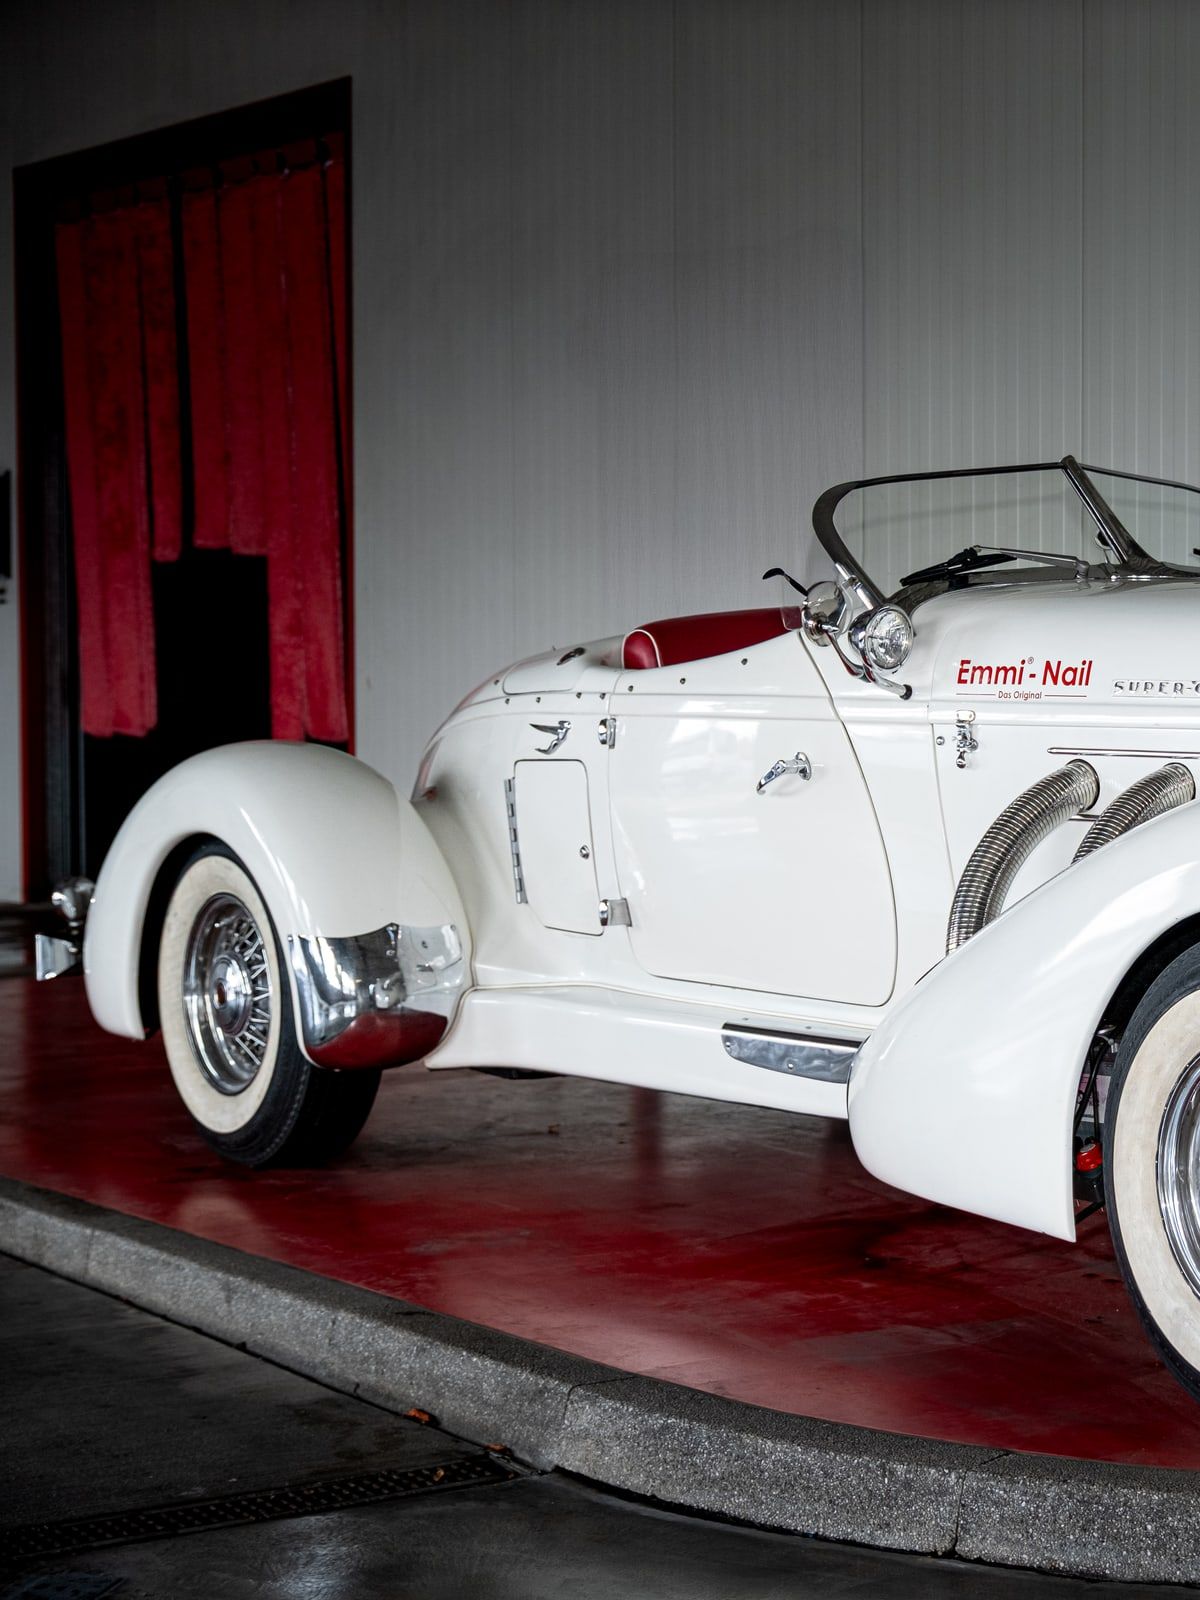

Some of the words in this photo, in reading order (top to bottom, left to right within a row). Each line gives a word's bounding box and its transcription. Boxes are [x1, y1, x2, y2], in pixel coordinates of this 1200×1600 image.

[1042, 660, 1093, 686] Nail
[998, 690, 1012, 699] Das
[1013, 690, 1042, 701] Original
